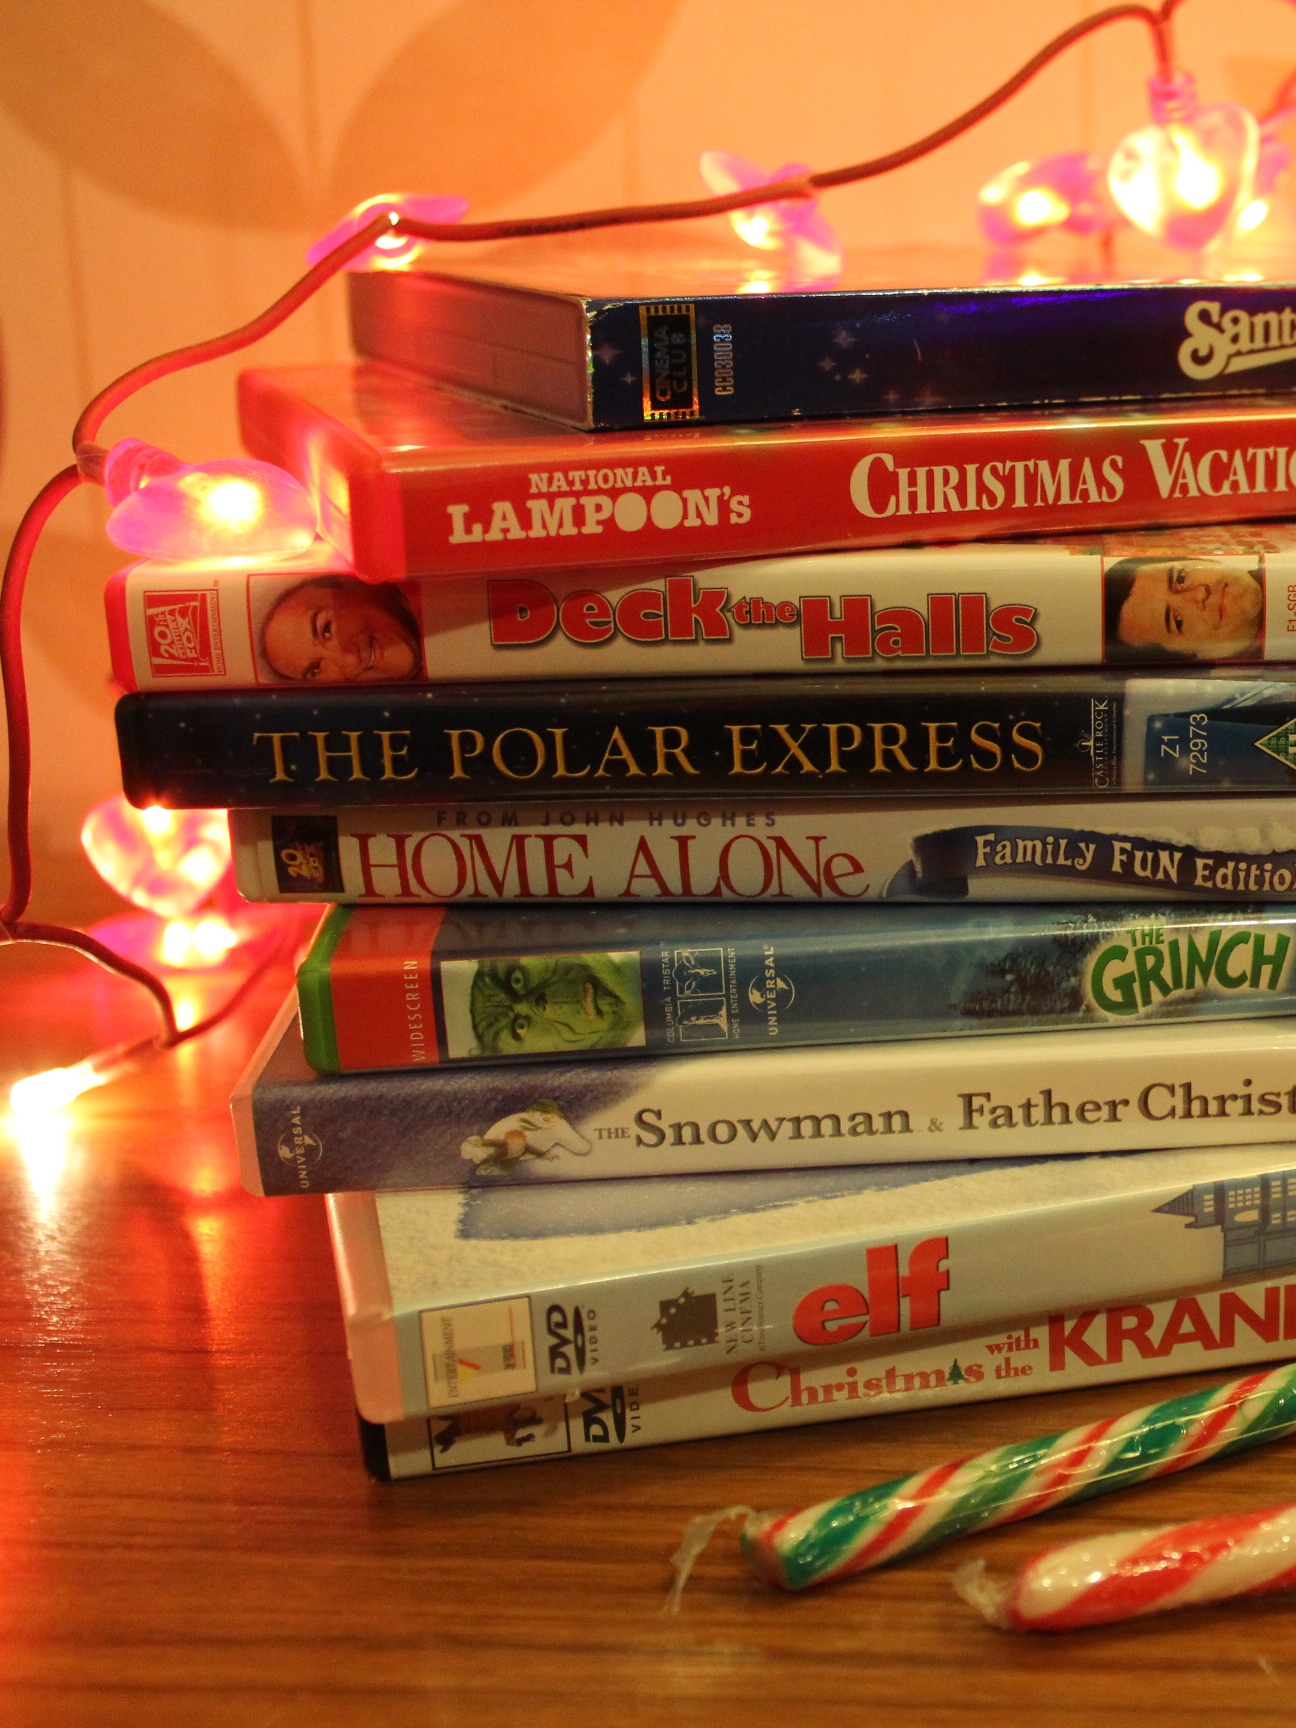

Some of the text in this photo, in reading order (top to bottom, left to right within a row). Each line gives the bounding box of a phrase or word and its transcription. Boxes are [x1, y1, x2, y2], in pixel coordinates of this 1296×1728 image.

[654, 325, 672, 401] CINEMA
[671, 333, 688, 393] CLUB
[713, 323, 734, 395] CCD30038
[529, 466, 671, 493] NATIONAL
[849, 452, 1124, 518] CHRISTMAS
[488, 576, 1038, 660] Deck the Halls
[252, 721, 1044, 783] THE POLAR EXPRESS
[1095, 700, 1109, 788] CASTLE ROCK
[1161, 735, 1179, 758] Z1
[1190, 713, 1208, 775] 72973
[436, 811, 777, 827] FROM JOHN HUGHES
[350, 833, 594, 898] HOME
[1126, 926, 1164, 947] THE
[662, 951, 675, 1042] COLUMBIA TRISTAR
[728, 948, 740, 1039] HOME ENTERTAINMENT
[764, 946, 778, 1035] UNIVERSAL
[1091, 929, 1290, 1016] GRINCH
[404, 961, 426, 1062] WIDESCREEN
[291, 1106, 309, 1188] UNIVERSAL
[595, 1127, 630, 1140] THE
[634, 1107, 914, 1148] Snowman
[927, 1118, 944, 1132] &
[957, 1089, 1131, 1131] Father
[722, 1273, 738, 1355] NEW LINE
[739, 1280, 753, 1343] CINEMA
[791, 1236, 950, 1346] elf
[546, 1304, 573, 1375] DVD
[587, 1309, 600, 1365] VIDEO
[985, 1328, 1040, 1355] with
[995, 1357, 1033, 1380] the
[628, 1387, 641, 1433] VIDE
[731, 1358, 985, 1414] Christms
